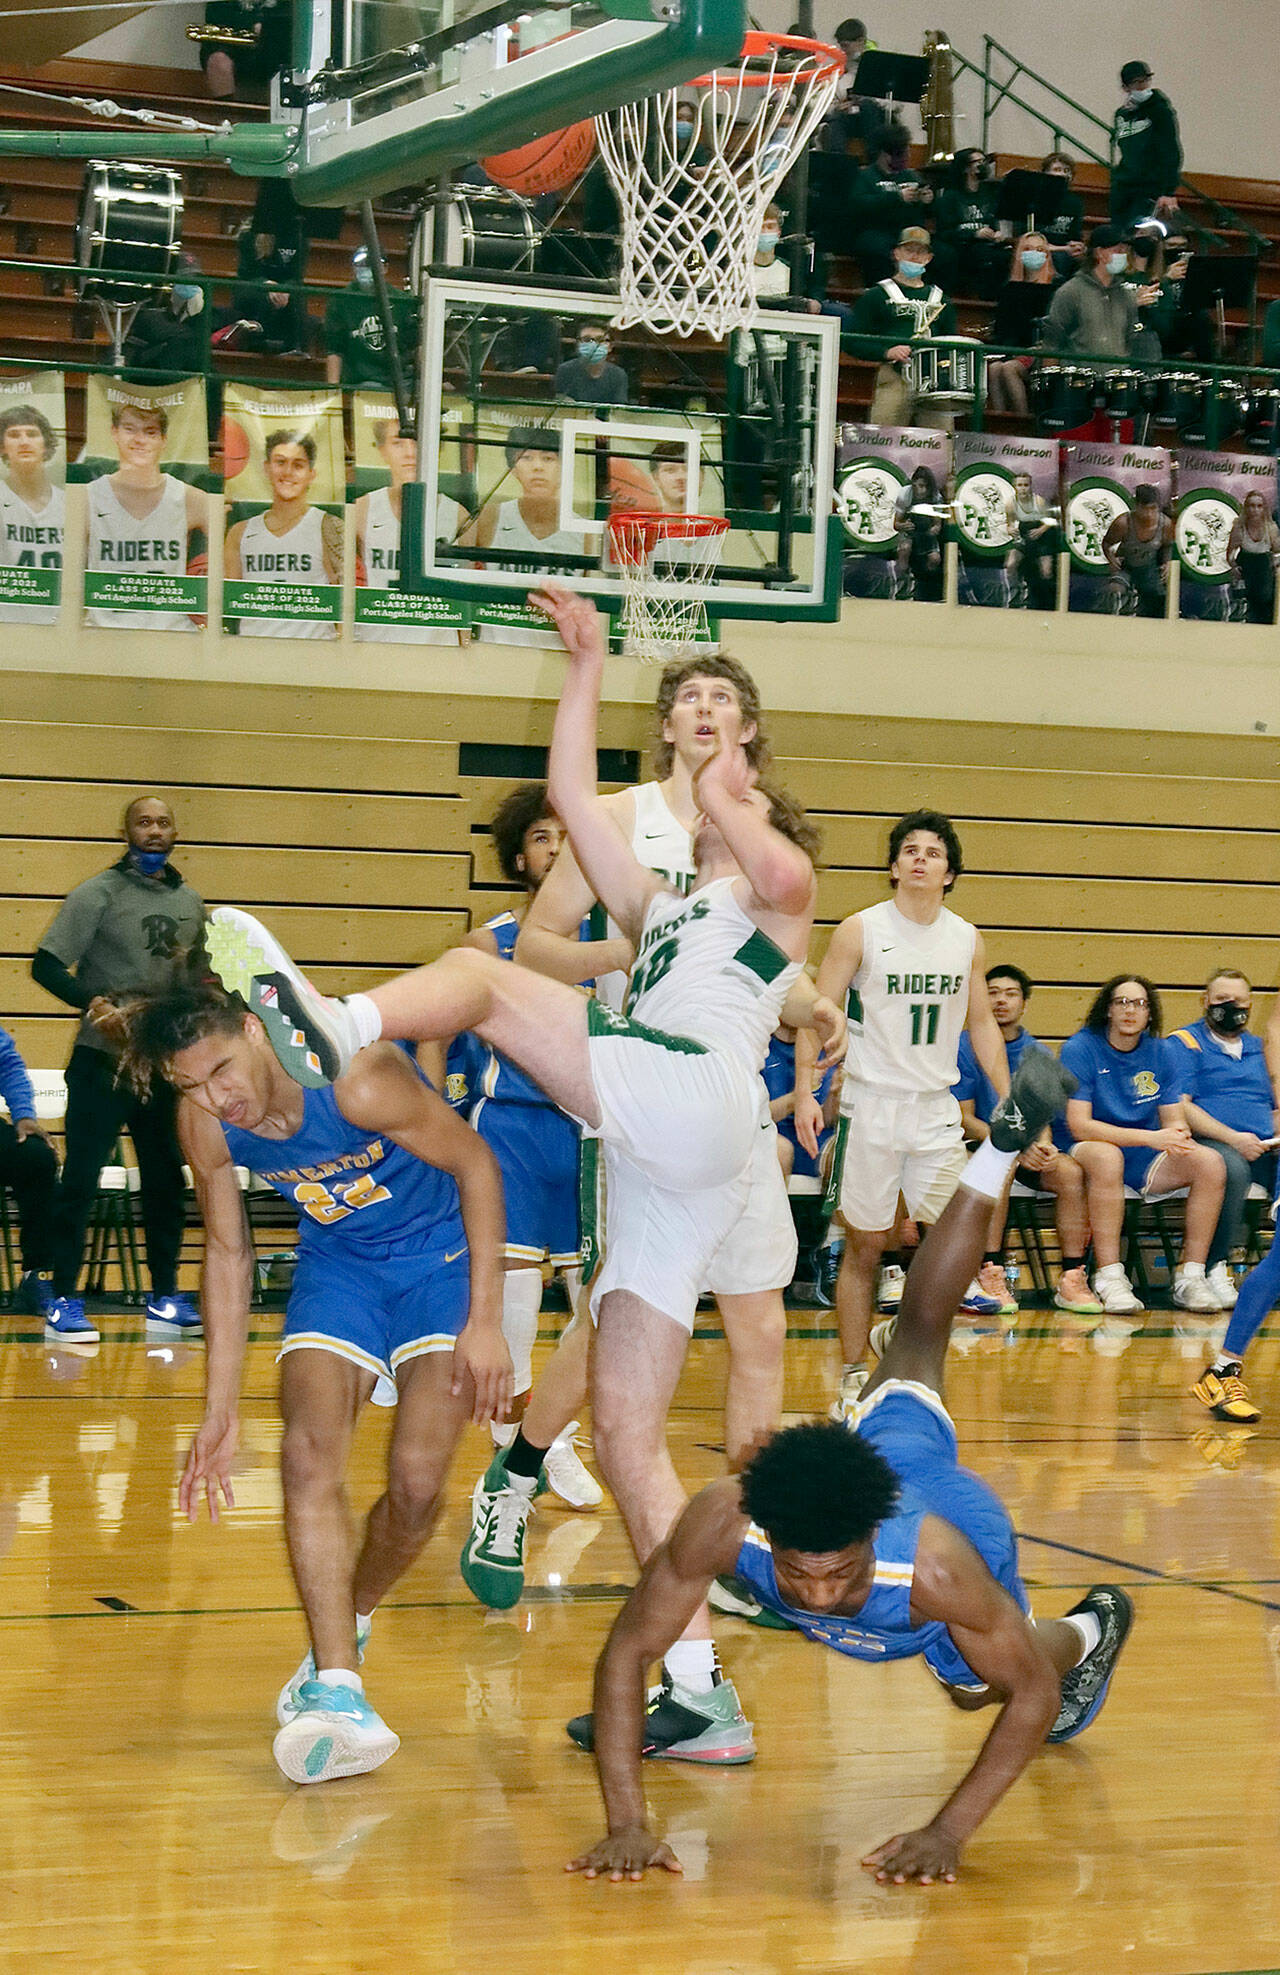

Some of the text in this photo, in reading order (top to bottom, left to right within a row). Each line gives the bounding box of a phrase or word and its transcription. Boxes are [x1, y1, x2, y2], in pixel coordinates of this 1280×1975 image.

[900, 434, 941, 450] Roarke
[1001, 444, 1052, 458] Anderson
[1076, 449, 1165, 470] Lance Menes
[1184, 455, 1236, 476] Kennedy
[100, 540, 181, 561] RIDERS
[245, 554, 312, 572] RIDERS
[13, 579, 38, 588] 2022
[120, 577, 177, 586] GRADUATE
[21, 589, 50, 598] School
[104, 584, 184, 595] CLASS OF 2022
[258, 586, 313, 596] GRADUATE
[93, 591, 197, 605] Port Angeles High School
[243, 593, 276, 602] CLASS
[297, 596, 320, 604] 2022
[232, 601, 333, 614] Port Angeles High School
[374, 600, 406, 608] CLASS
[426, 603, 451, 611] 2022
[363, 608, 463, 621] Port Angeles High School
[479, 608, 549, 622] Port Angeles High
[886, 973, 964, 995] RIDERS
[910, 1004, 941, 1045] 11
[294, 1174, 393, 1225] 22
